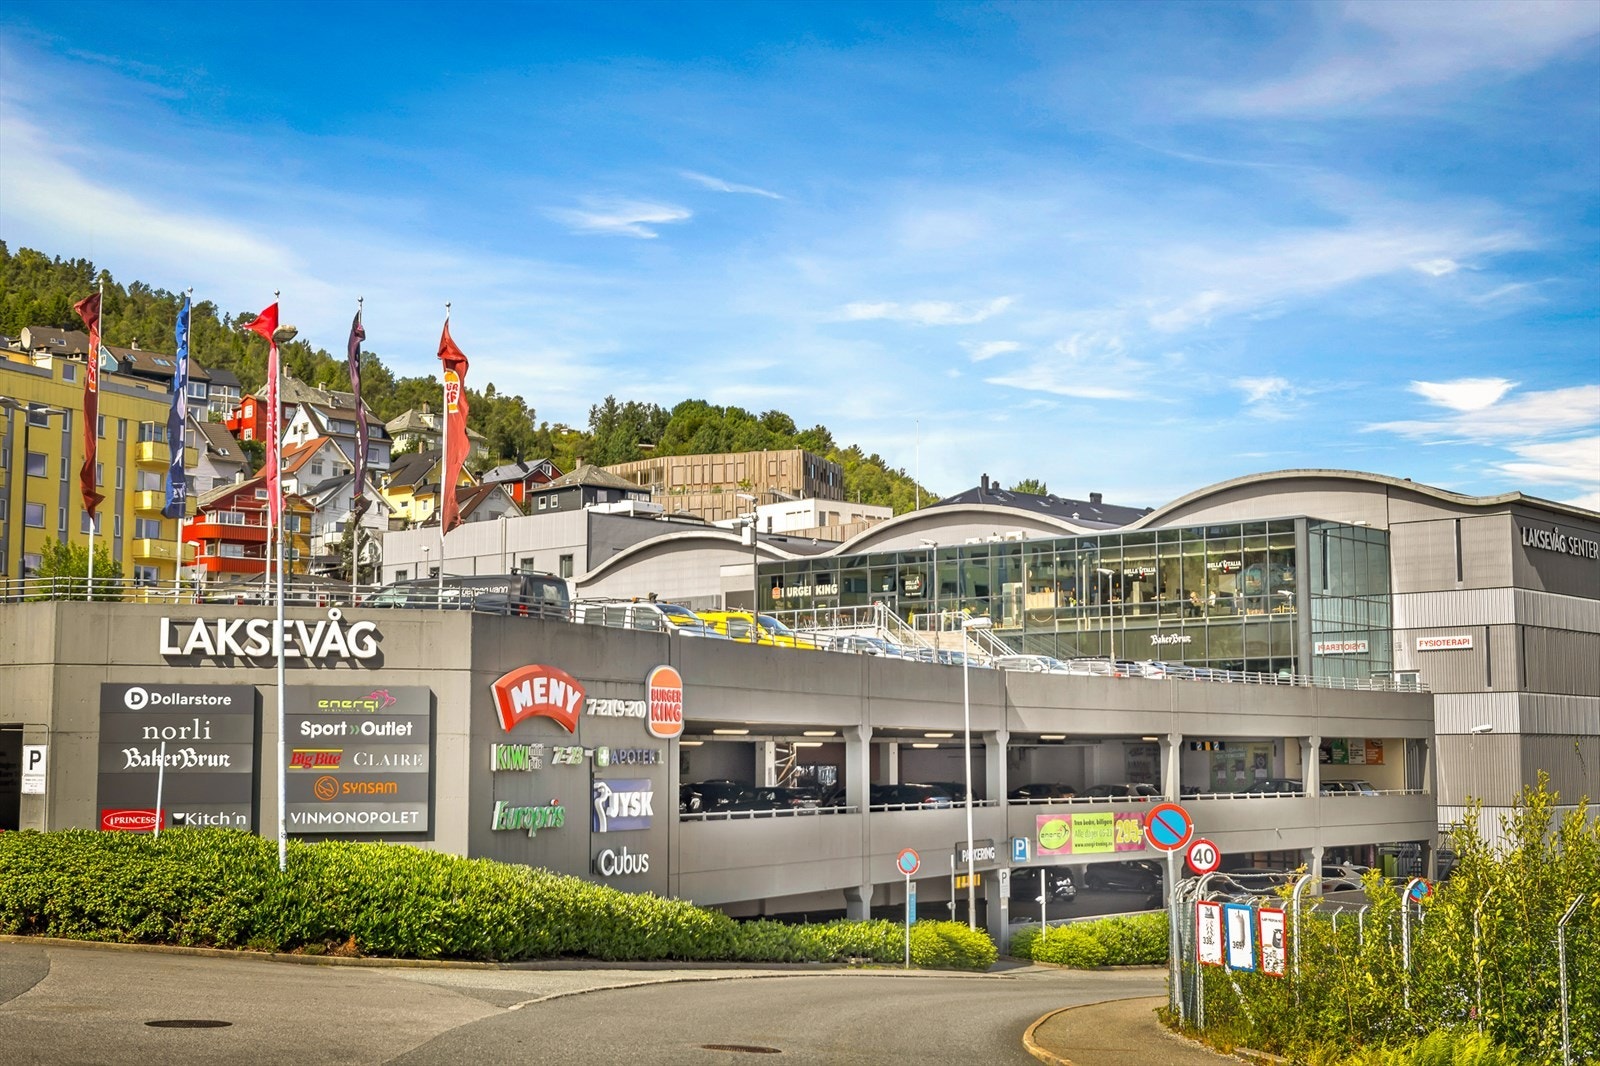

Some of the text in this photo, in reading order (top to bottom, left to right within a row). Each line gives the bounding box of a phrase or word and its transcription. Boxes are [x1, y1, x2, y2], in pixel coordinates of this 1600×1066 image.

[1522, 526, 1599, 560] LAKSEVÅG SENTER
[815, 584, 838, 596] KING
[160, 607, 377, 659] LAKSEVÅG
[1418, 637, 1470, 648] FYSIOTERAPI
[151, 692, 232, 706] Dollarstore
[510, 677, 581, 714] MENY
[650, 688, 681, 703] BURGER
[318, 699, 379, 712] energi
[650, 703, 681, 723] KING
[142, 717, 212, 740] norli
[300, 720, 413, 738] Sport Outlet
[29, 749, 42, 771] P
[290, 752, 342, 769] Big Bite
[353, 752, 423, 767] CLAIRE
[496, 743, 530, 771] KIWI
[611, 748, 656, 766] APOTEK
[342, 782, 398, 795] SYNSAM
[606, 791, 654, 818] JYSK
[290, 811, 419, 825] VINMONOPOLET
[491, 798, 566, 838] Europris
[1115, 818, 1144, 845] 295,-
[962, 846, 995, 863] PAKERING
[1015, 840, 1025, 855] P
[599, 846, 649, 877] Cubus
[1192, 848, 1214, 865] 40
[1002, 872, 1007, 884] P
